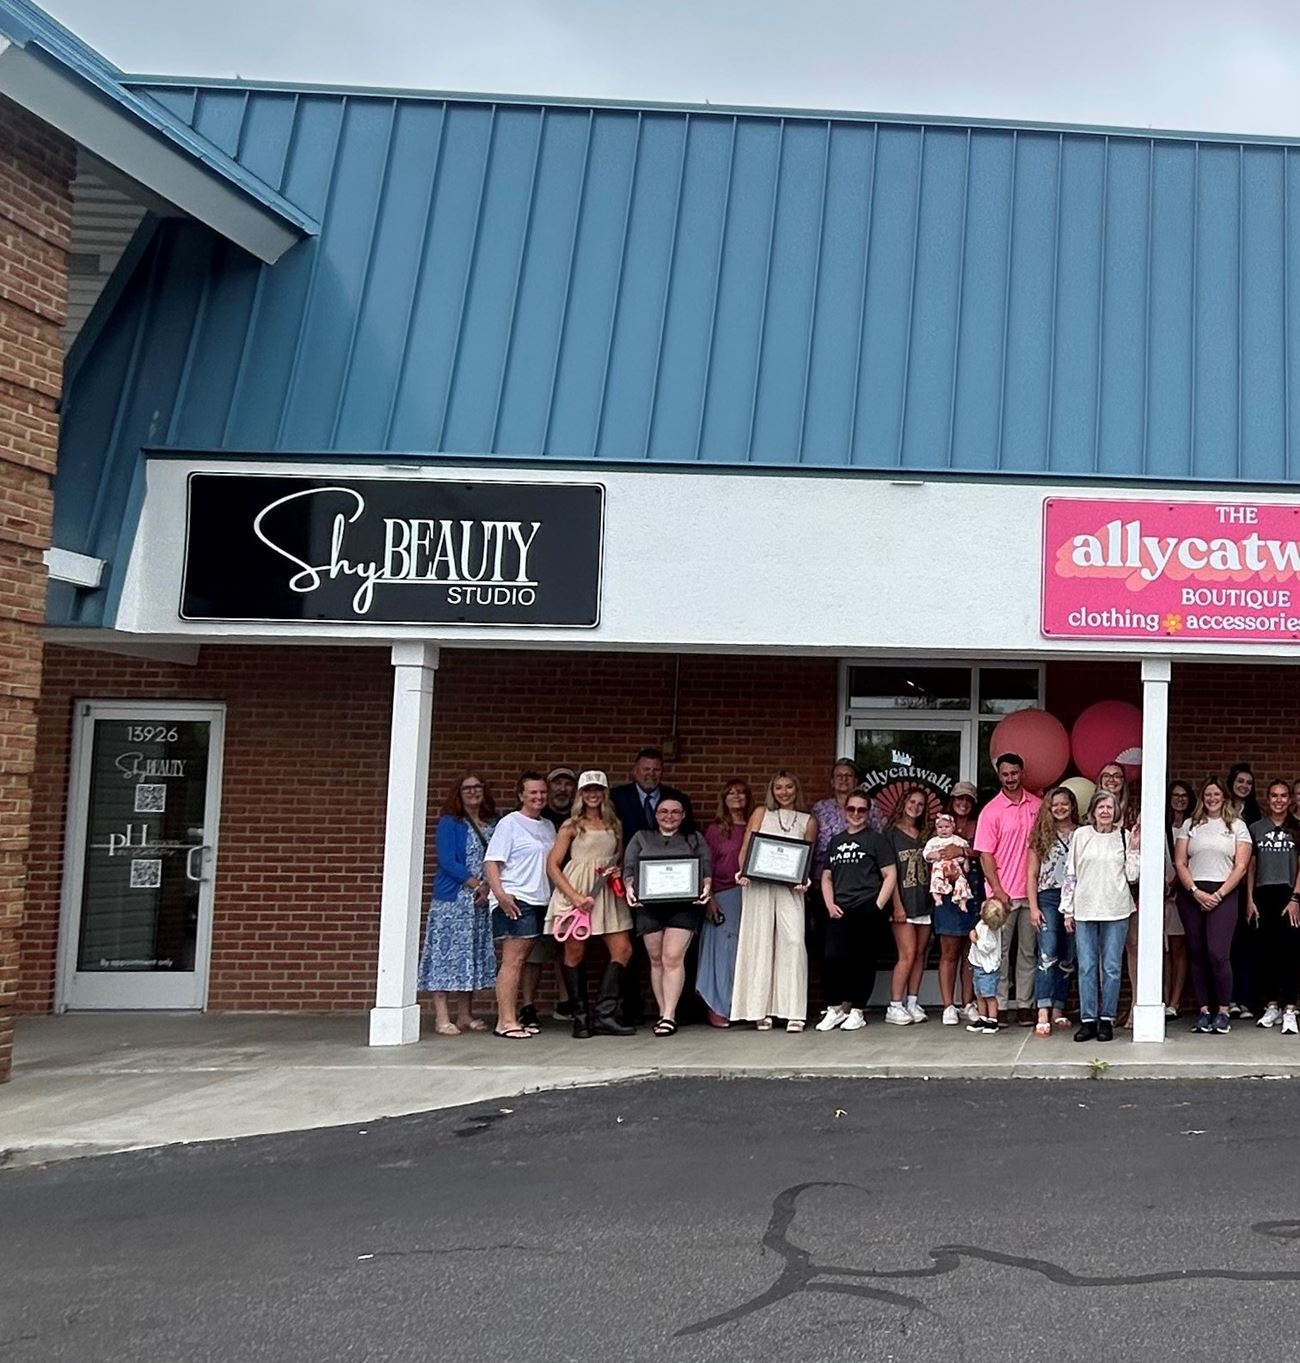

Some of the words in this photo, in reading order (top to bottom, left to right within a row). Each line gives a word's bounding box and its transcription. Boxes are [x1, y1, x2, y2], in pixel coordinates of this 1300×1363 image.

[1215, 507, 1258, 525] THE
[253, 487, 385, 614] Shy
[383, 518, 543, 582] BEAUTY
[446, 586, 536, 606] STUDIO
[1181, 588, 1291, 609] BOUTIQUE
[1068, 607, 1160, 631] clothing
[127, 726, 178, 742] 13926
[861, 765, 953, 795] allycatwalk
